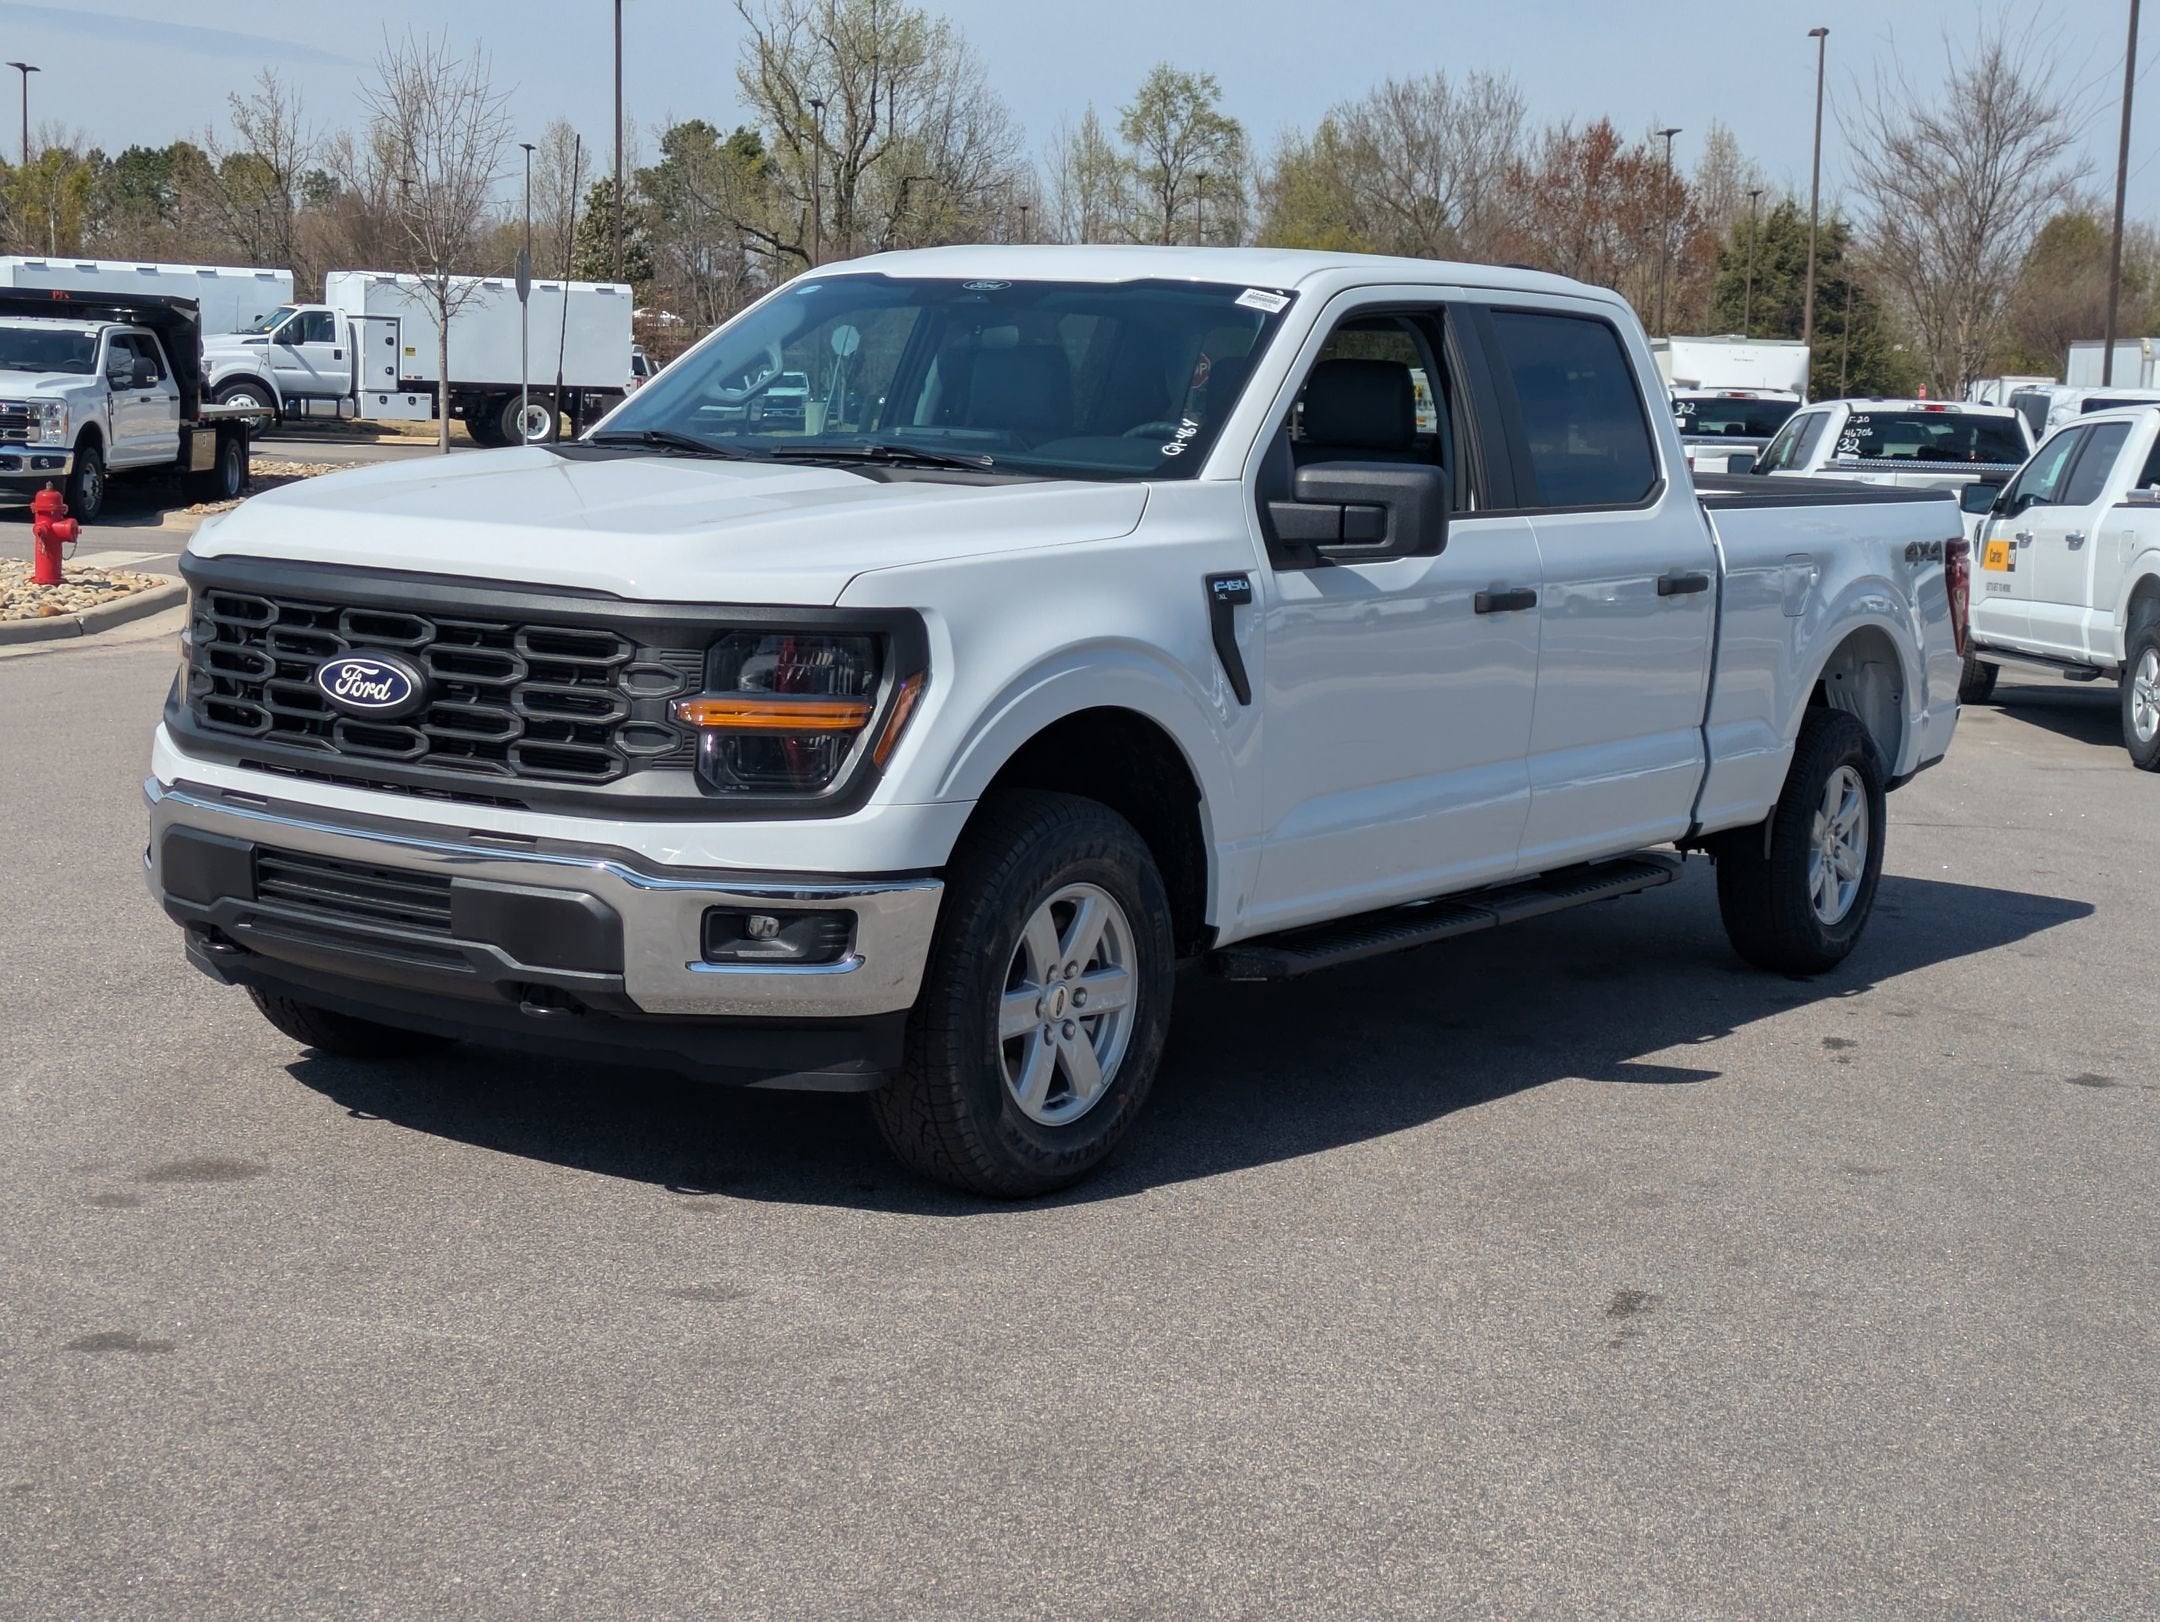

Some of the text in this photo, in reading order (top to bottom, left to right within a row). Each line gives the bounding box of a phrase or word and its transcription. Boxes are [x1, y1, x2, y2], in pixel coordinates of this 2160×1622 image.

[1674, 401, 1697, 416] 32
[1836, 437, 1862, 454] 32
[334, 663, 394, 701] Ford
